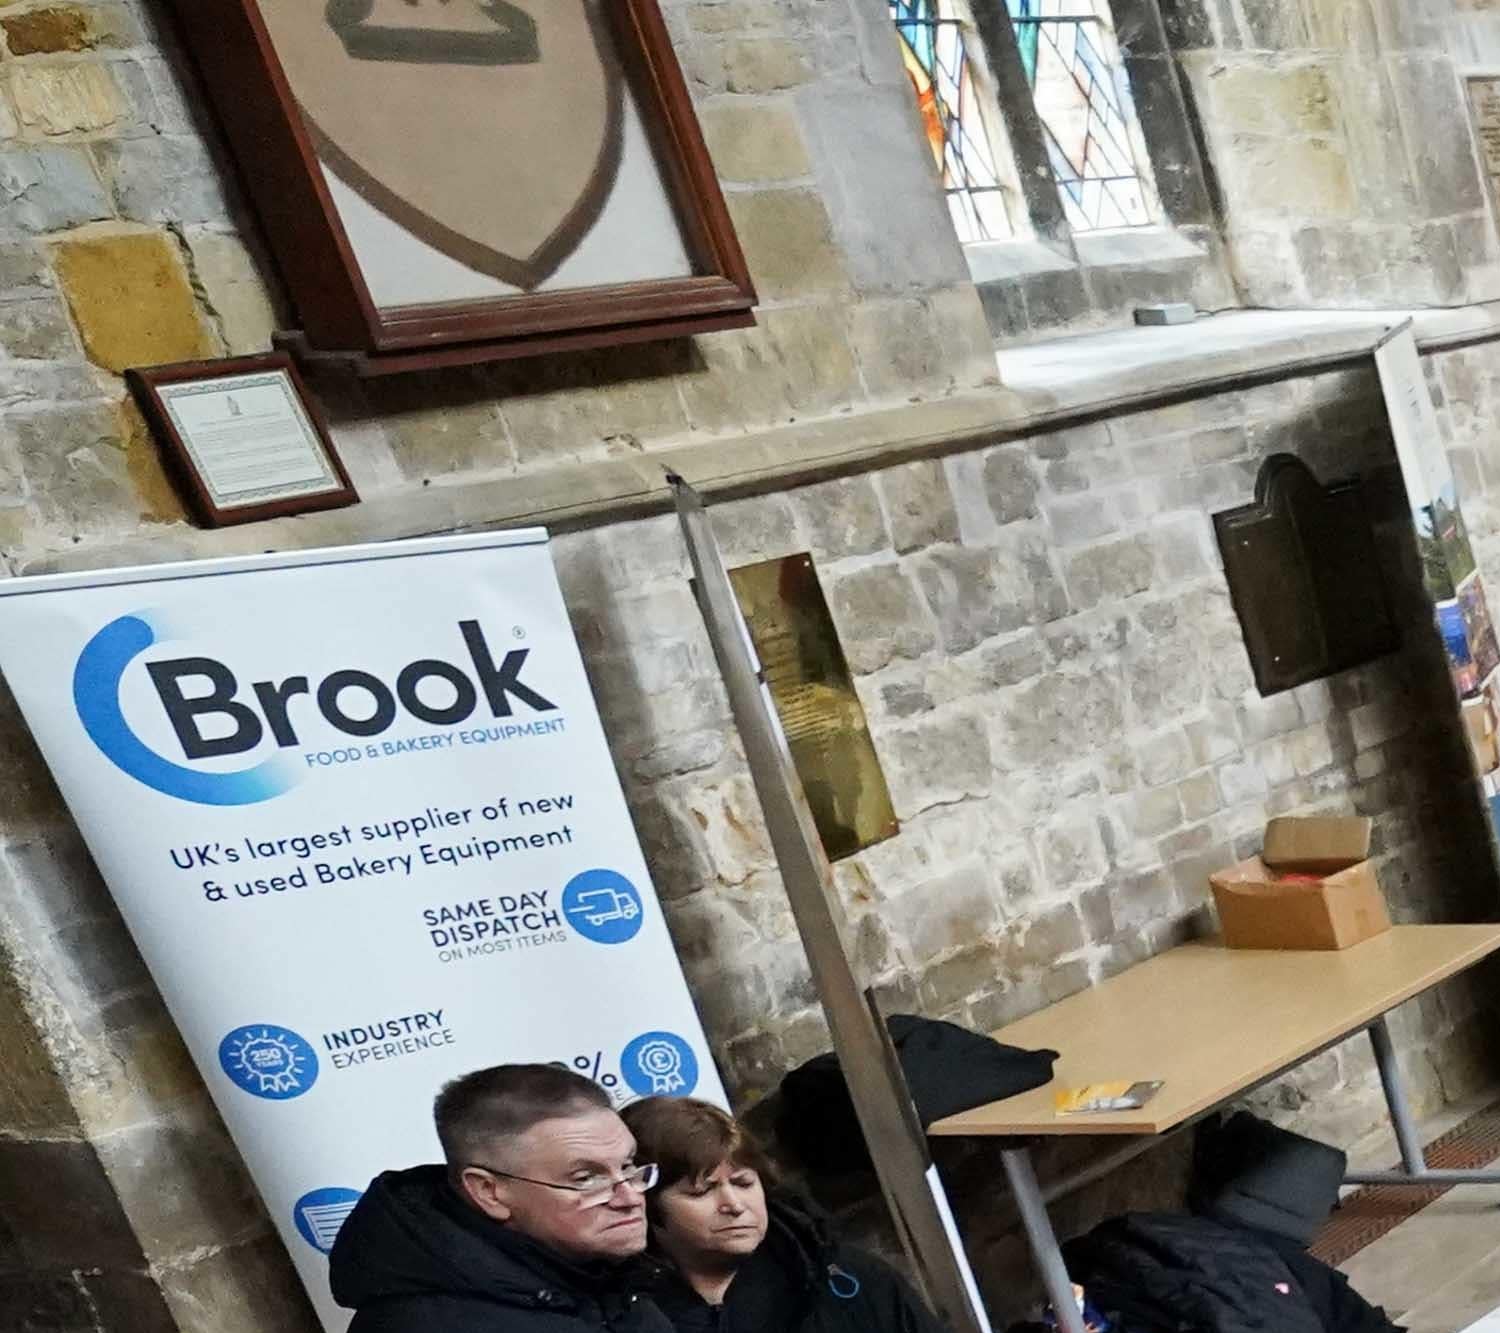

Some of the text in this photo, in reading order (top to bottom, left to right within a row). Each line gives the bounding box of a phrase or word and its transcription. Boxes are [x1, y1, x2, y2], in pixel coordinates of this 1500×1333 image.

[144, 618, 559, 761] Brook
[305, 718, 567, 768] FOOD & BAKERY EQUIPMENT
[169, 794, 575, 870] UK's largest supplier of new
[203, 825, 574, 903] & used Bakery Equipment
[422, 890, 550, 927] SAME DAY
[430, 909, 562, 948] DISPATCH
[438, 929, 568, 964] ON MOST ITEMS
[322, 1008, 446, 1052] INDUSTRY
[331, 1027, 456, 1070] EXPERIENCE
